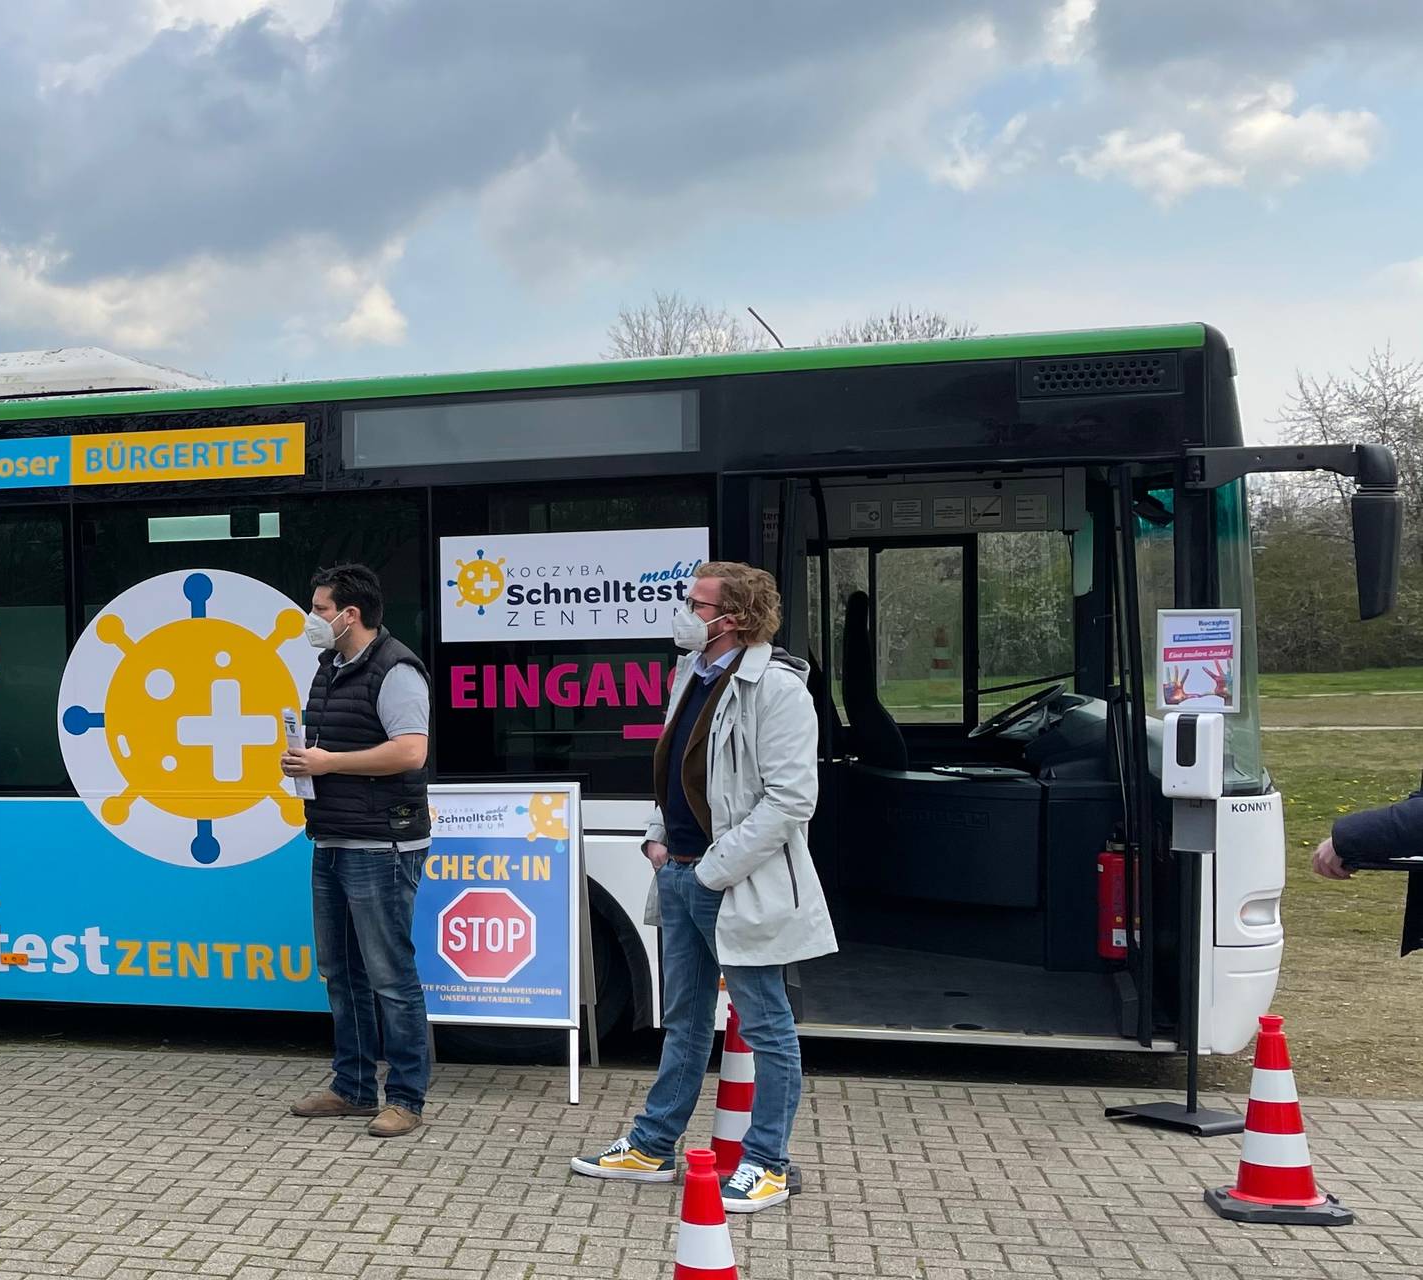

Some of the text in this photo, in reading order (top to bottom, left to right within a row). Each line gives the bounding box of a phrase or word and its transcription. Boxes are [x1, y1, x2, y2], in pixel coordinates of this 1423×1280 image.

[85, 437, 290, 474] BÜRGERTEST
[506, 564, 605, 578] KOCZYBA
[506, 580, 687, 606] Schnelltest
[507, 608, 678, 627] ZENTRU
[450, 661, 677, 709] EINGAN
[437, 813, 504, 824] Schnelltest
[425, 854, 551, 881] CHECK-IN
[448, 916, 526, 953] STOP
[115, 940, 317, 983] ZENTRU
